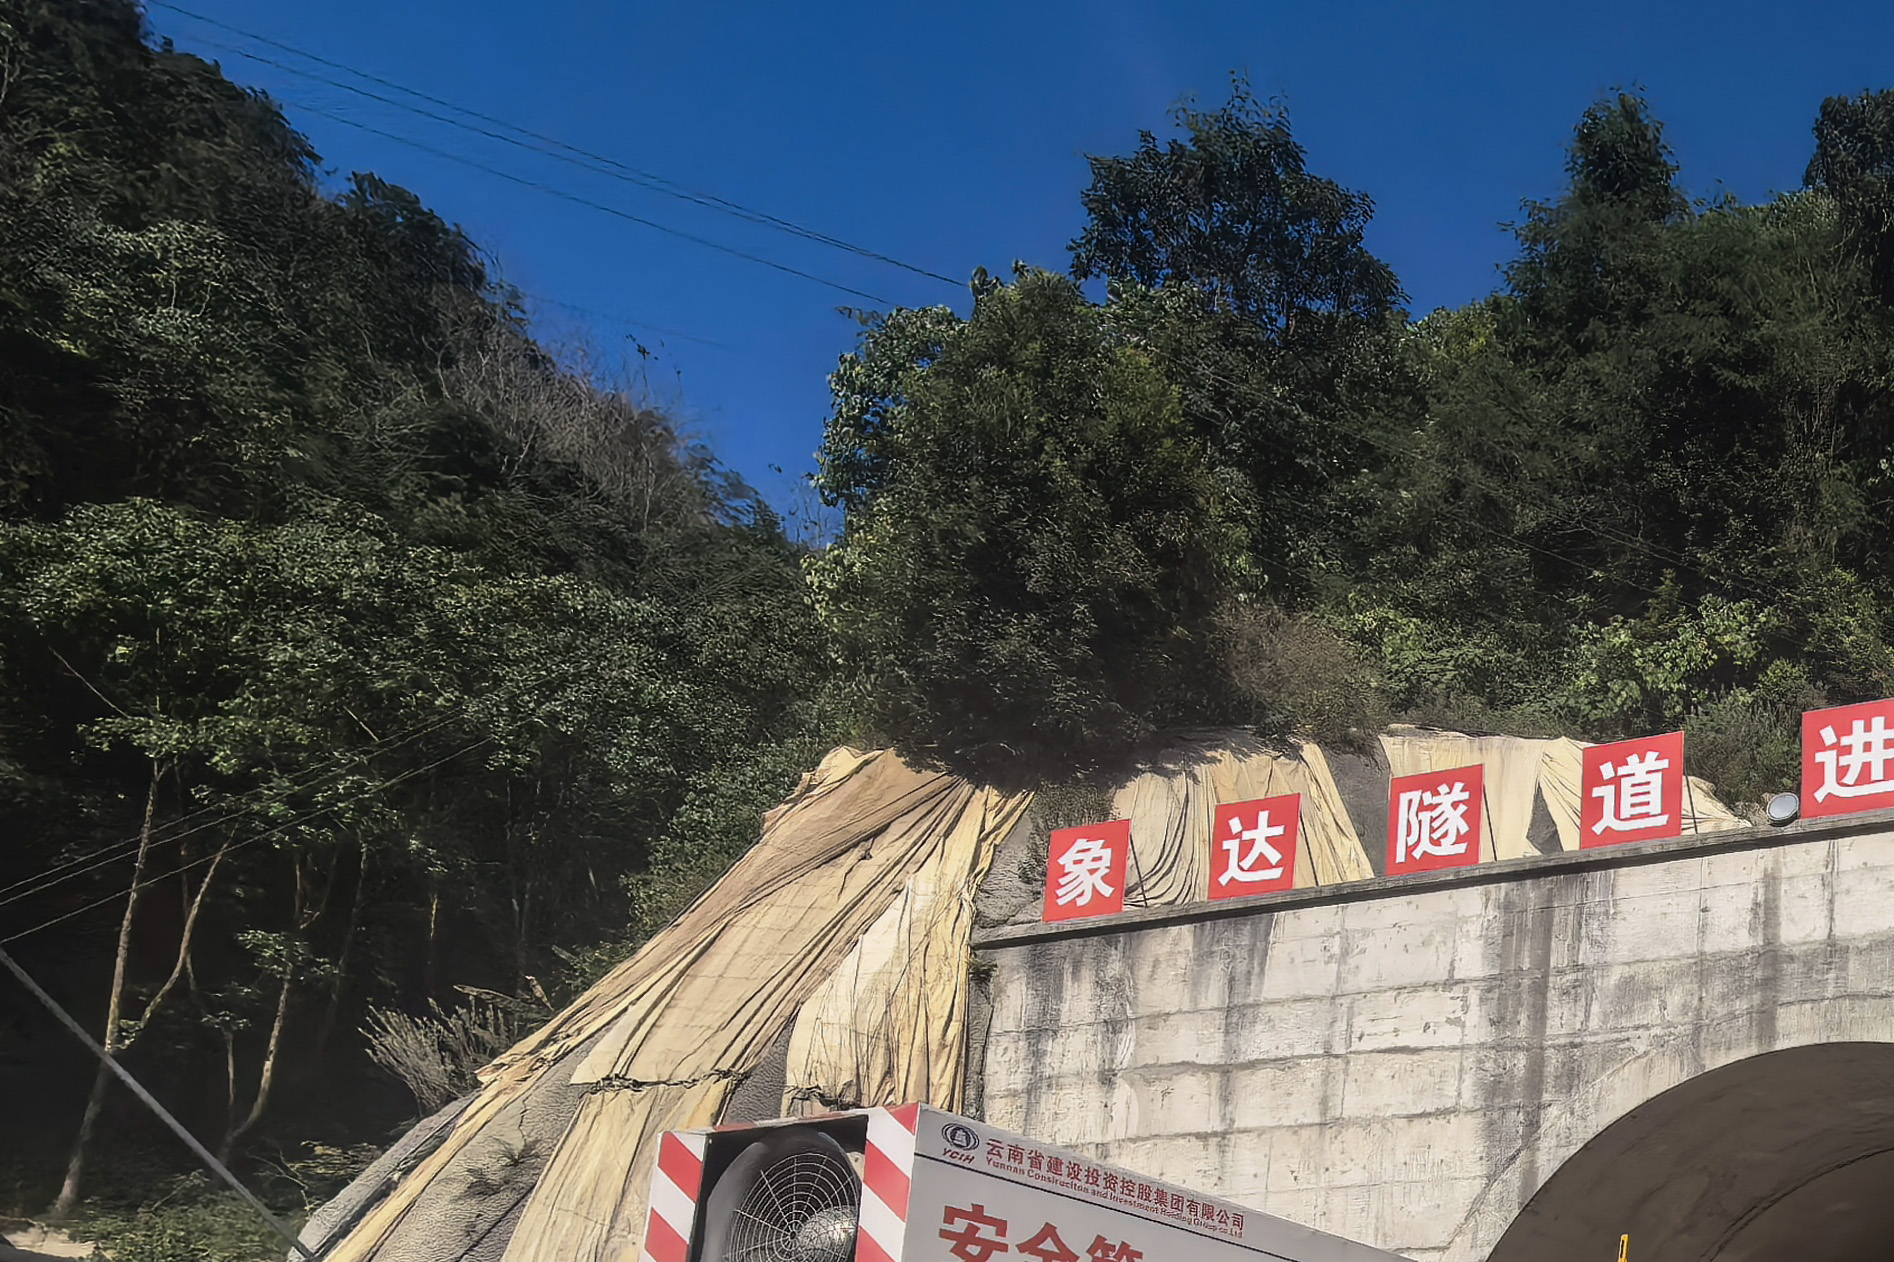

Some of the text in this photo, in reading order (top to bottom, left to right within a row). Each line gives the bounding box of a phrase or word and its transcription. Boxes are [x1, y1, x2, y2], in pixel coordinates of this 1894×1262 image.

[986, 1156, 1025, 1175] Yunnan
[986, 1138, 1245, 1231] 云南省建设投资控股集团有限公司
